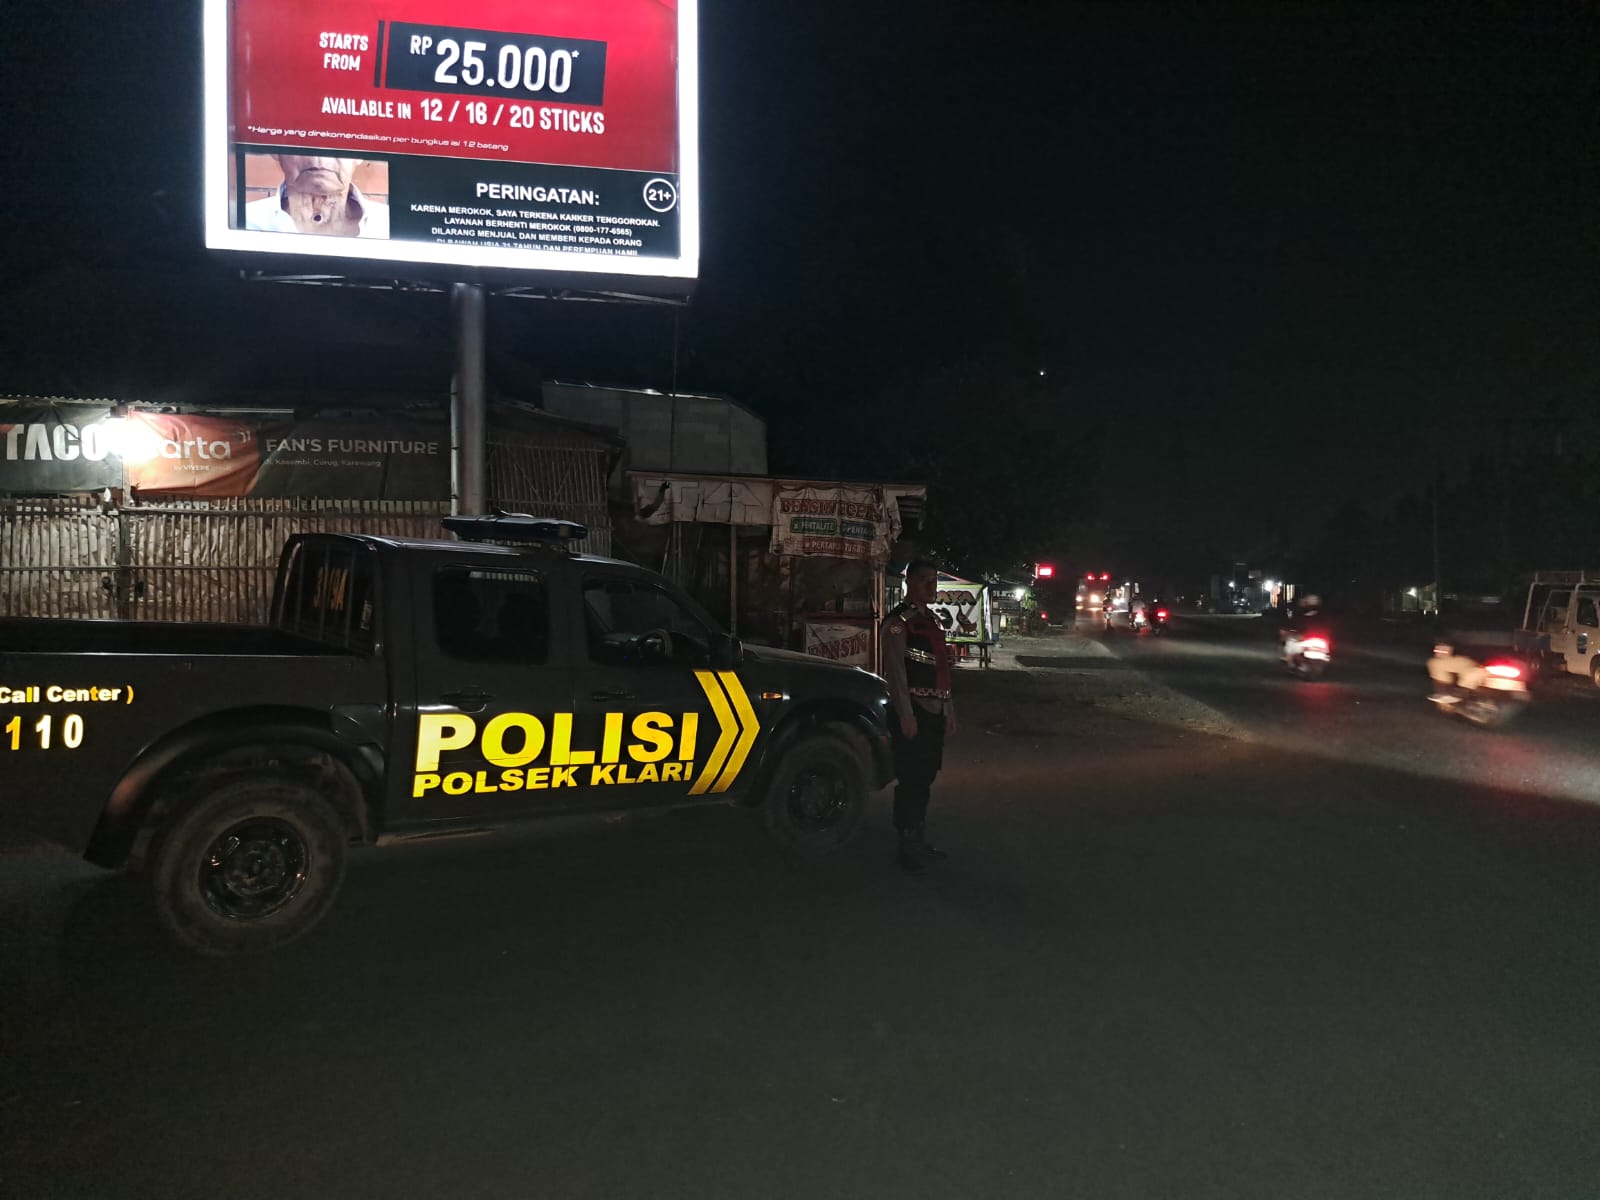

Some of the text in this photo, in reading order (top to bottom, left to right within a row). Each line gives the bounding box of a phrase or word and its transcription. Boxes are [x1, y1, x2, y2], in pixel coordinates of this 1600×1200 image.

[319, 32, 369, 51] STARTS
[410, 35, 432, 55] RP
[323, 53, 360, 71] FROM
[321, 96, 605, 135] AVAILABLE IN 12 / 16 / 20 STICKS
[284, 128, 306, 138] yang
[308, 129, 392, 142] direkomendasikan
[393, 136, 410, 145] per
[411, 136, 449, 147] bungkus
[463, 140, 476, 148] 12
[477, 141, 509, 152] batang
[476, 183, 600, 206] PERINGATAN:
[648, 189, 672, 202] 21+
[411, 204, 447, 214] KARENA
[496, 209, 518, 218] SAYA
[519, 210, 559, 220] TERKENA
[560, 213, 594, 223] KANKER
[444, 217, 484, 227] LAYANAN
[485, 219, 527, 229] BERHENTI
[529, 222, 571, 232] MEROKOK
[431, 227, 643, 248] DILARANG MENJUAL DAN MEMBERI KEPADA ORANG
[0, 424, 107, 468] TACO
[154, 437, 231, 460] arta
[266, 439, 438, 455] FAN'S FURNITURE
[0, 686, 40, 704] Call
[46, 685, 122, 703] Center
[415, 711, 699, 773] POLISI
[413, 761, 694, 798] POLSEK KLARI
